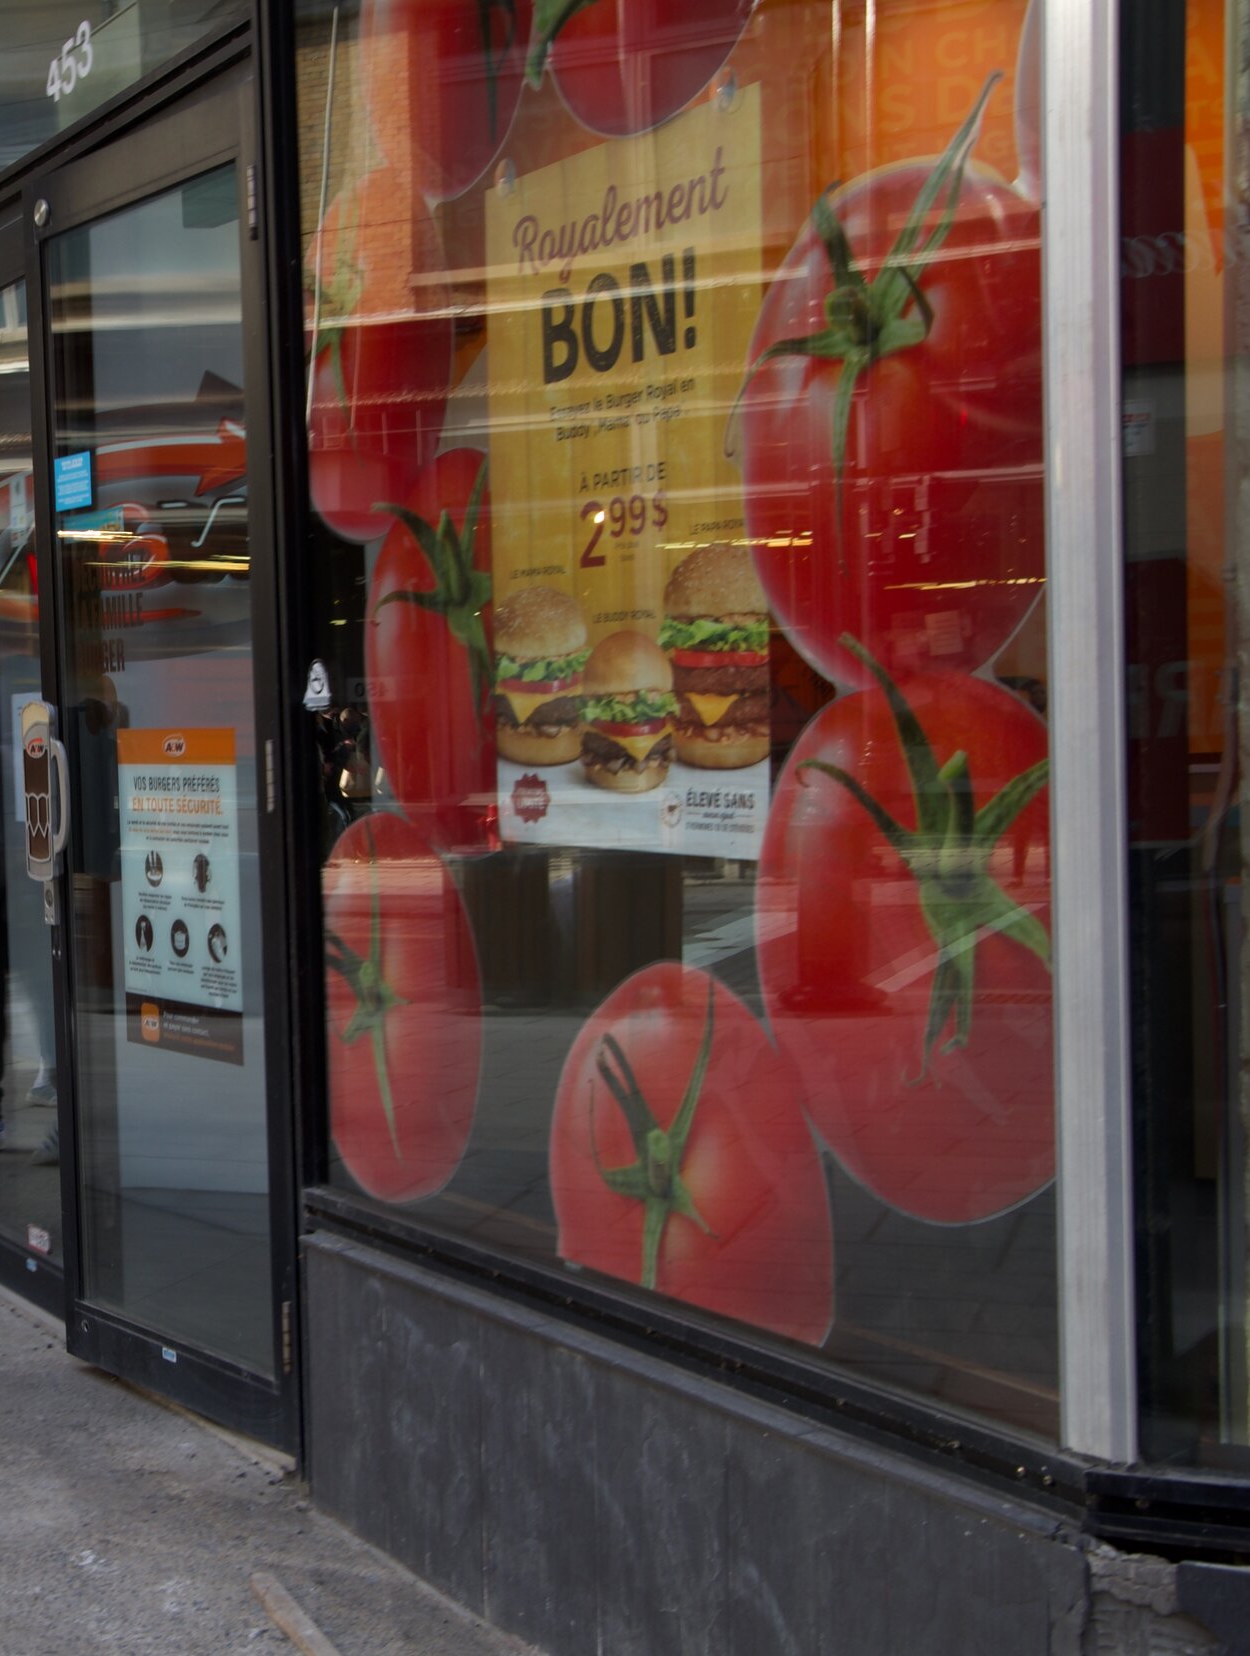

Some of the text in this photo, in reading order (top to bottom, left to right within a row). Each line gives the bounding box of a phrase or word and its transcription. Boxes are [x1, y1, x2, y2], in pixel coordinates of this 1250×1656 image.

[46, 20, 93, 102] 453
[513, 146, 730, 283] Royalement
[541, 247, 697, 385] BON!
[605, 390, 644, 409] Burger
[646, 379, 678, 401] Royal
[680, 378, 695, 393] en
[579, 461, 667, 493] À PARTIR DE
[133, 774, 220, 793] VOS BURGERS PRÉFÉRÉS
[686, 787, 755, 810] ÉLEVÉ SANS
[132, 797, 144, 812] EN
[145, 797, 175, 813] TOUTE
